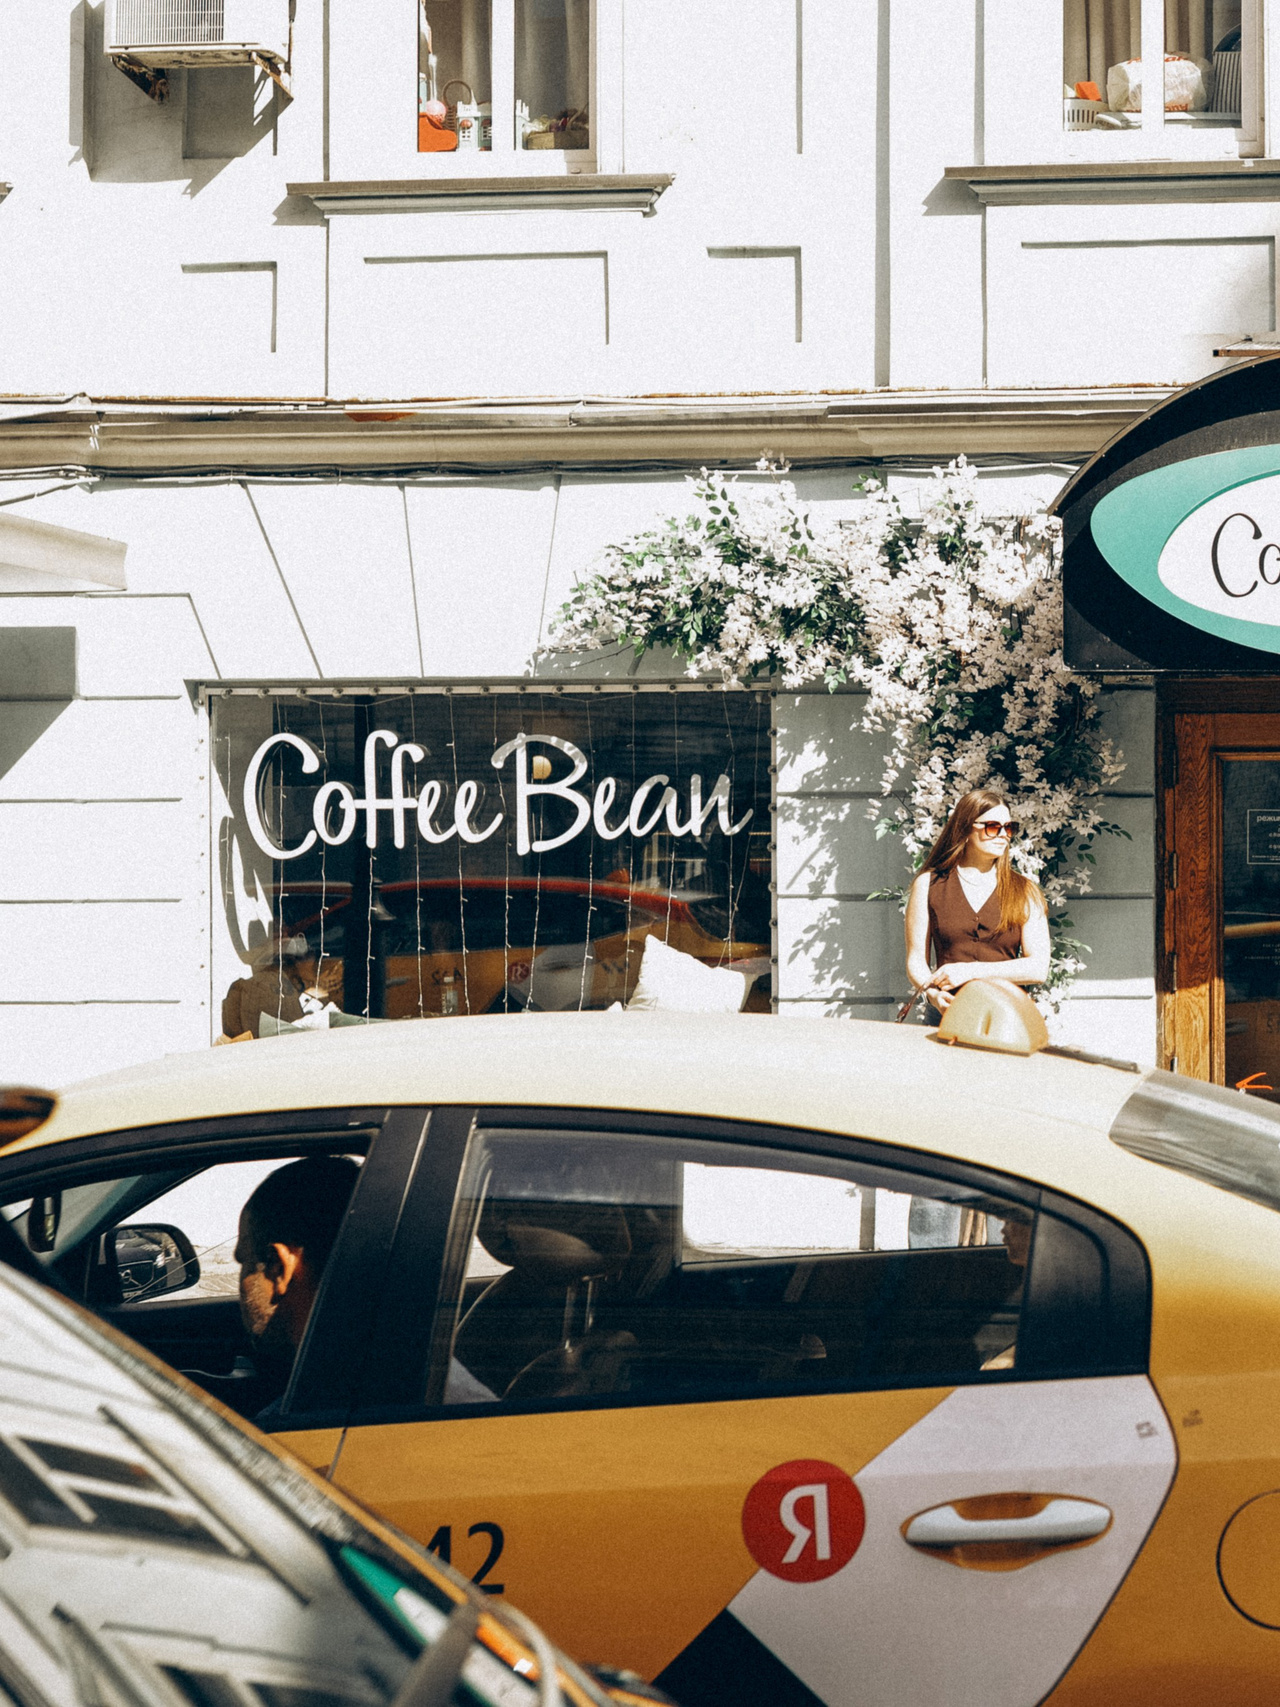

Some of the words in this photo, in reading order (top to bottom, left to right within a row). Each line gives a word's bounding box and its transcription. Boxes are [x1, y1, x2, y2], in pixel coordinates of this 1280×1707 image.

[243, 730, 503, 860] Coffee
[491, 732, 754, 856] Bean
[779, 1482, 832, 1564] Я
